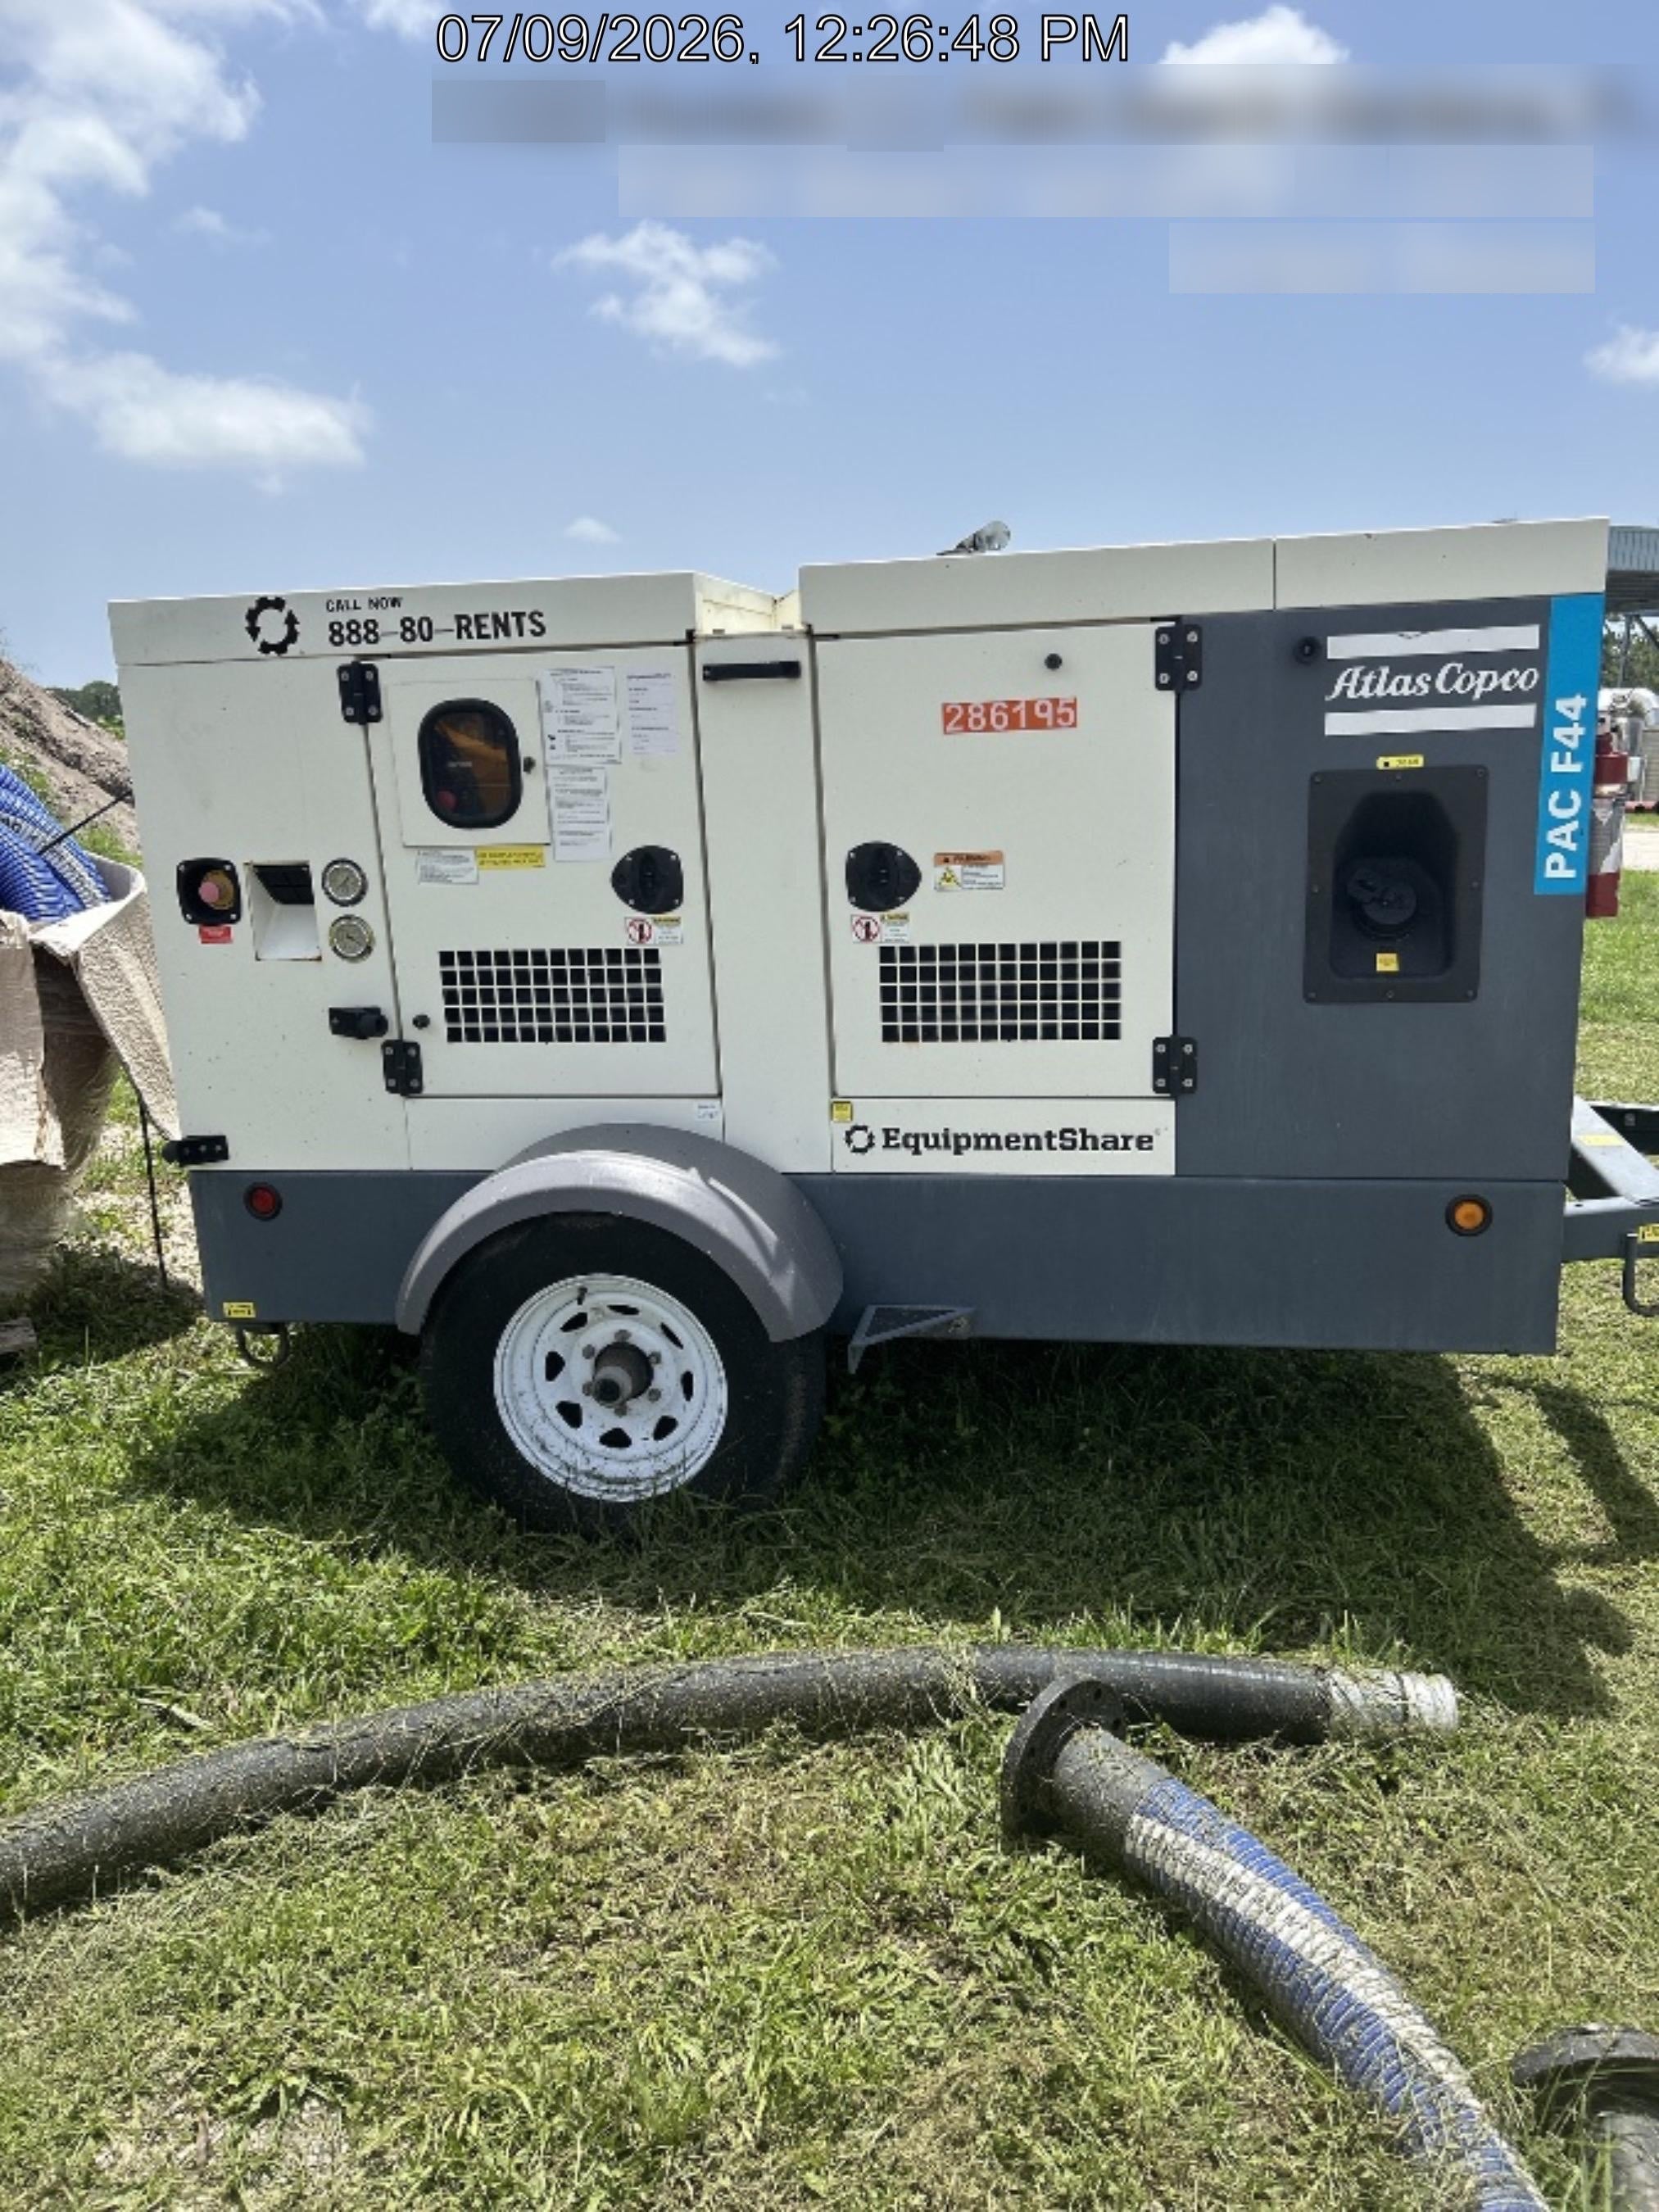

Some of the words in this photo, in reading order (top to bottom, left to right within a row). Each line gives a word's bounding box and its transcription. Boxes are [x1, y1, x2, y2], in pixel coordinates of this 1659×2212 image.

[325, 598, 361, 613] CALL
[368, 596, 403, 610] NOW
[1325, 666, 1431, 701] Atlas
[1435, 662, 1540, 700] Copco
[944, 699, 1076, 732] 286195
[1551, 693, 1587, 773] F44
[1544, 789, 1581, 879] PAC
[882, 1127, 1154, 1156] EquipmentShare
